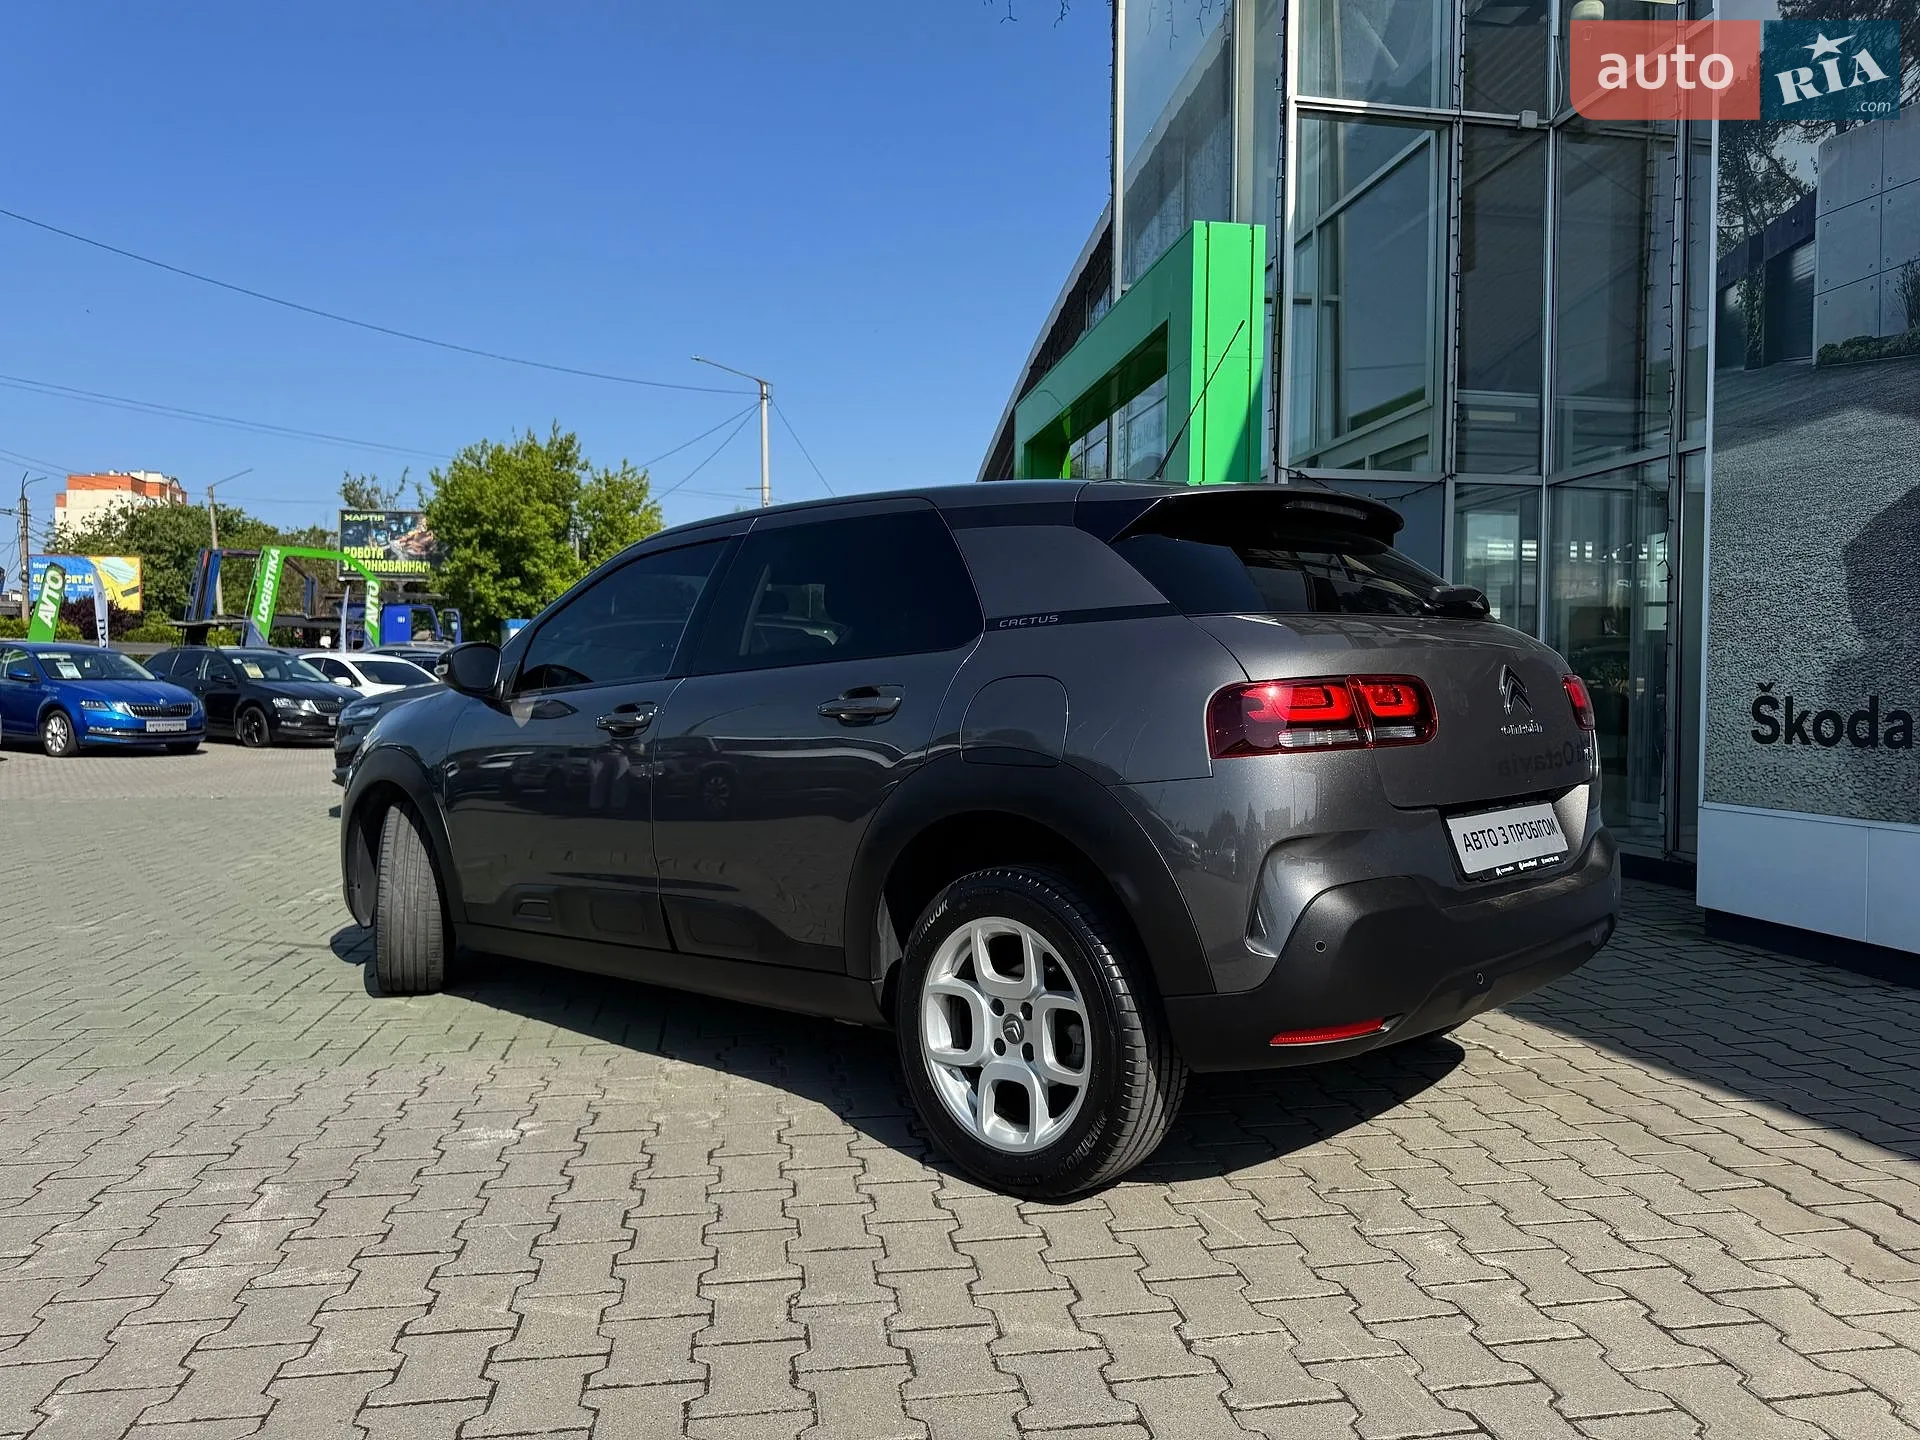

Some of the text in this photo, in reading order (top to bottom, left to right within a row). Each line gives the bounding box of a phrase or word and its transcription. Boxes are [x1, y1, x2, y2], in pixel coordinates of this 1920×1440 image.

[343, 546, 384, 559] РОБОТА
[38, 570, 64, 629] AVTO
[257, 548, 281, 624] LOGISTIKA
[365, 580, 379, 628] AVTO
[999, 614, 1059, 628] CACTUS
[1751, 682, 1914, 750] Škoda
[1462, 828, 1499, 853] АВТО
[1508, 817, 1559, 843] ПРОБІГОМ
